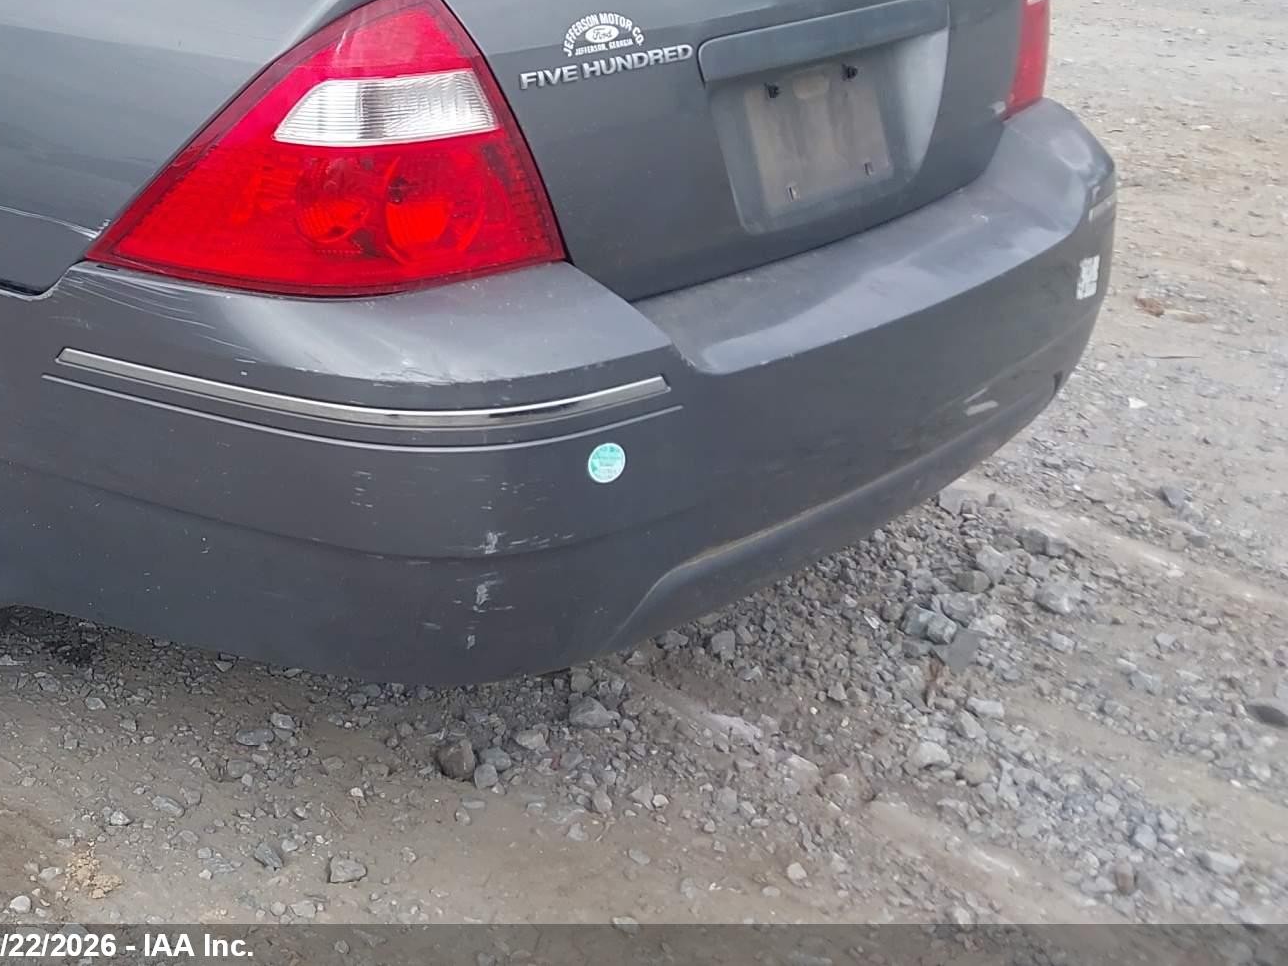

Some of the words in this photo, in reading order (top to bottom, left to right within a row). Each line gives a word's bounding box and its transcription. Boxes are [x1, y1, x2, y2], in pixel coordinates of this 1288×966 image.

[563, 14, 599, 57] JEFFERSON
[599, 12, 633, 32] MOTOR
[608, 37, 634, 50] GEORGIA
[520, 64, 578, 90] FIVE
[581, 44, 693, 79] HUNDRED
